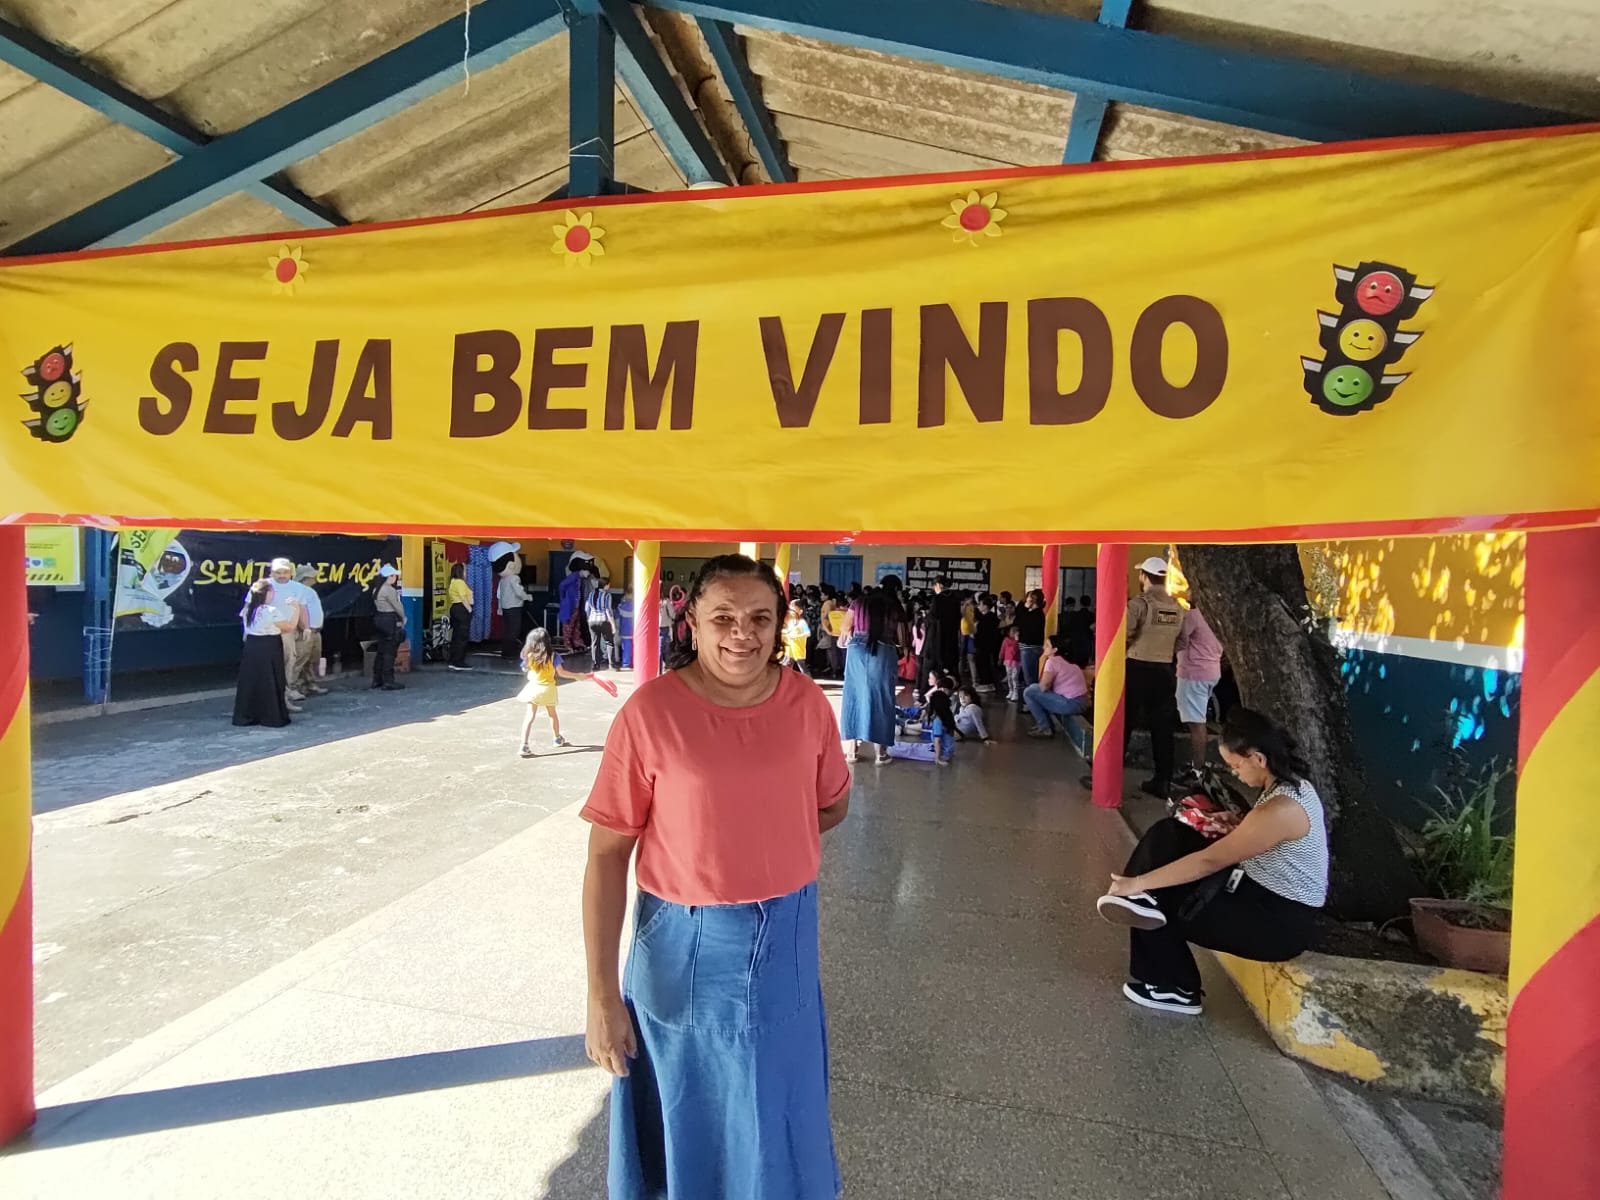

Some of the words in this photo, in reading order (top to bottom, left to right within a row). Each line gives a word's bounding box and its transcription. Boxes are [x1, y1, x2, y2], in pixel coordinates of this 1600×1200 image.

[137, 338, 393, 441] SEJA
[449, 319, 700, 438] BEM
[758, 294, 1230, 429] VINDO
[315, 561, 346, 585] EM
